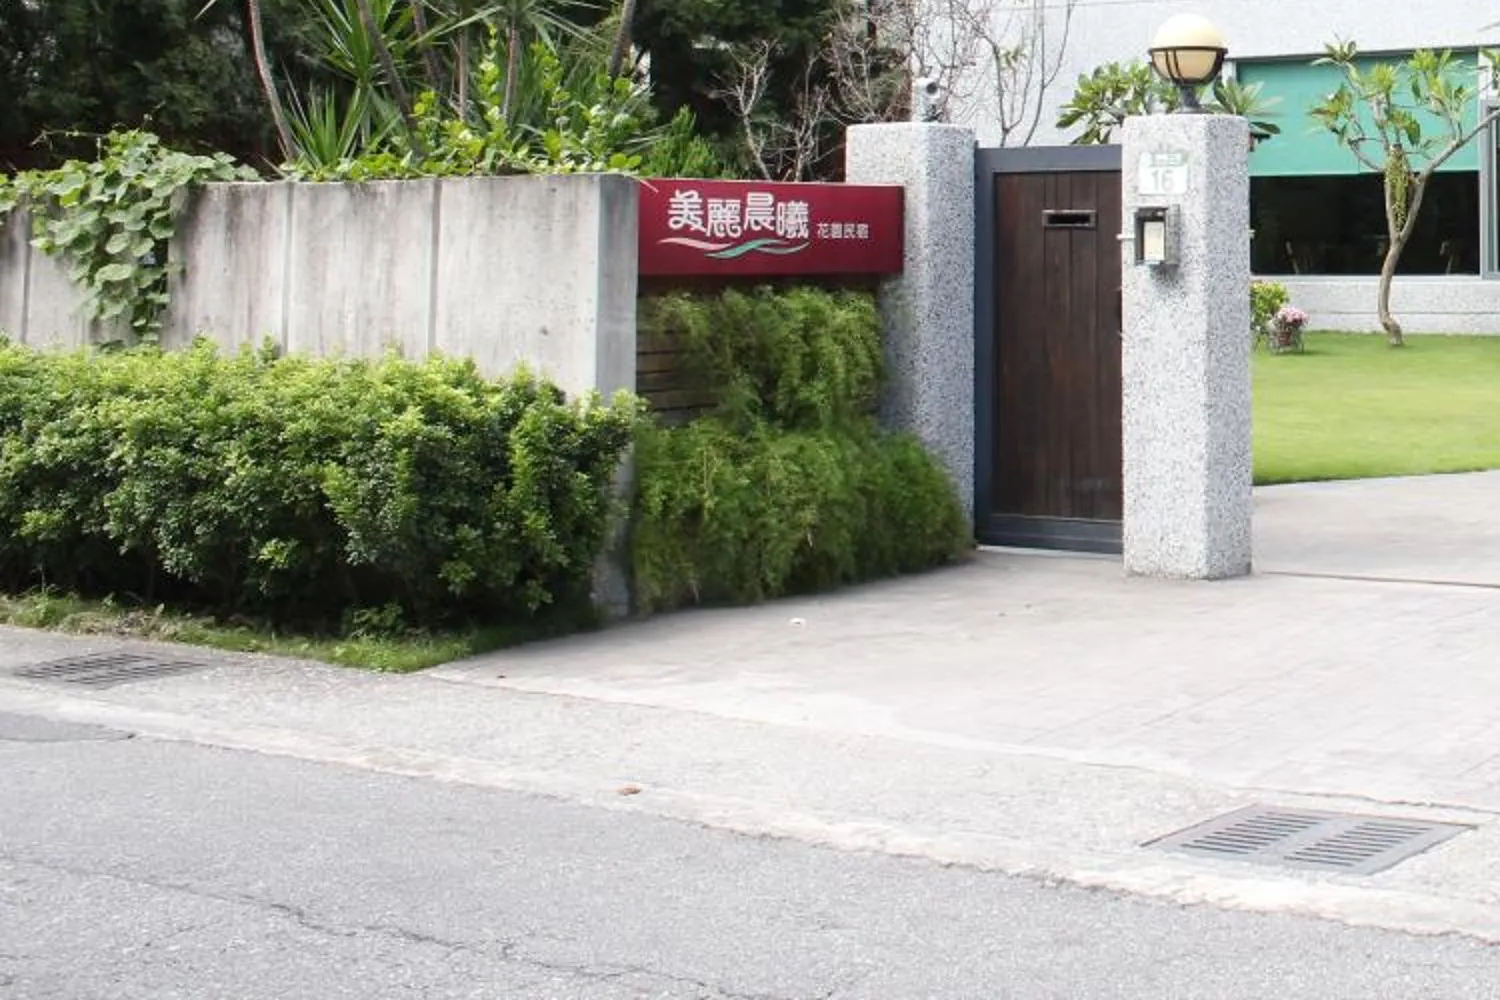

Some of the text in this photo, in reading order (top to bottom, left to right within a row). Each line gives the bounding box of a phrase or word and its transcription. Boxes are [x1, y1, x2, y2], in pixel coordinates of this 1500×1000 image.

[1151, 169, 1175, 192] 16
[667, 189, 809, 239] 美麗晨曦
